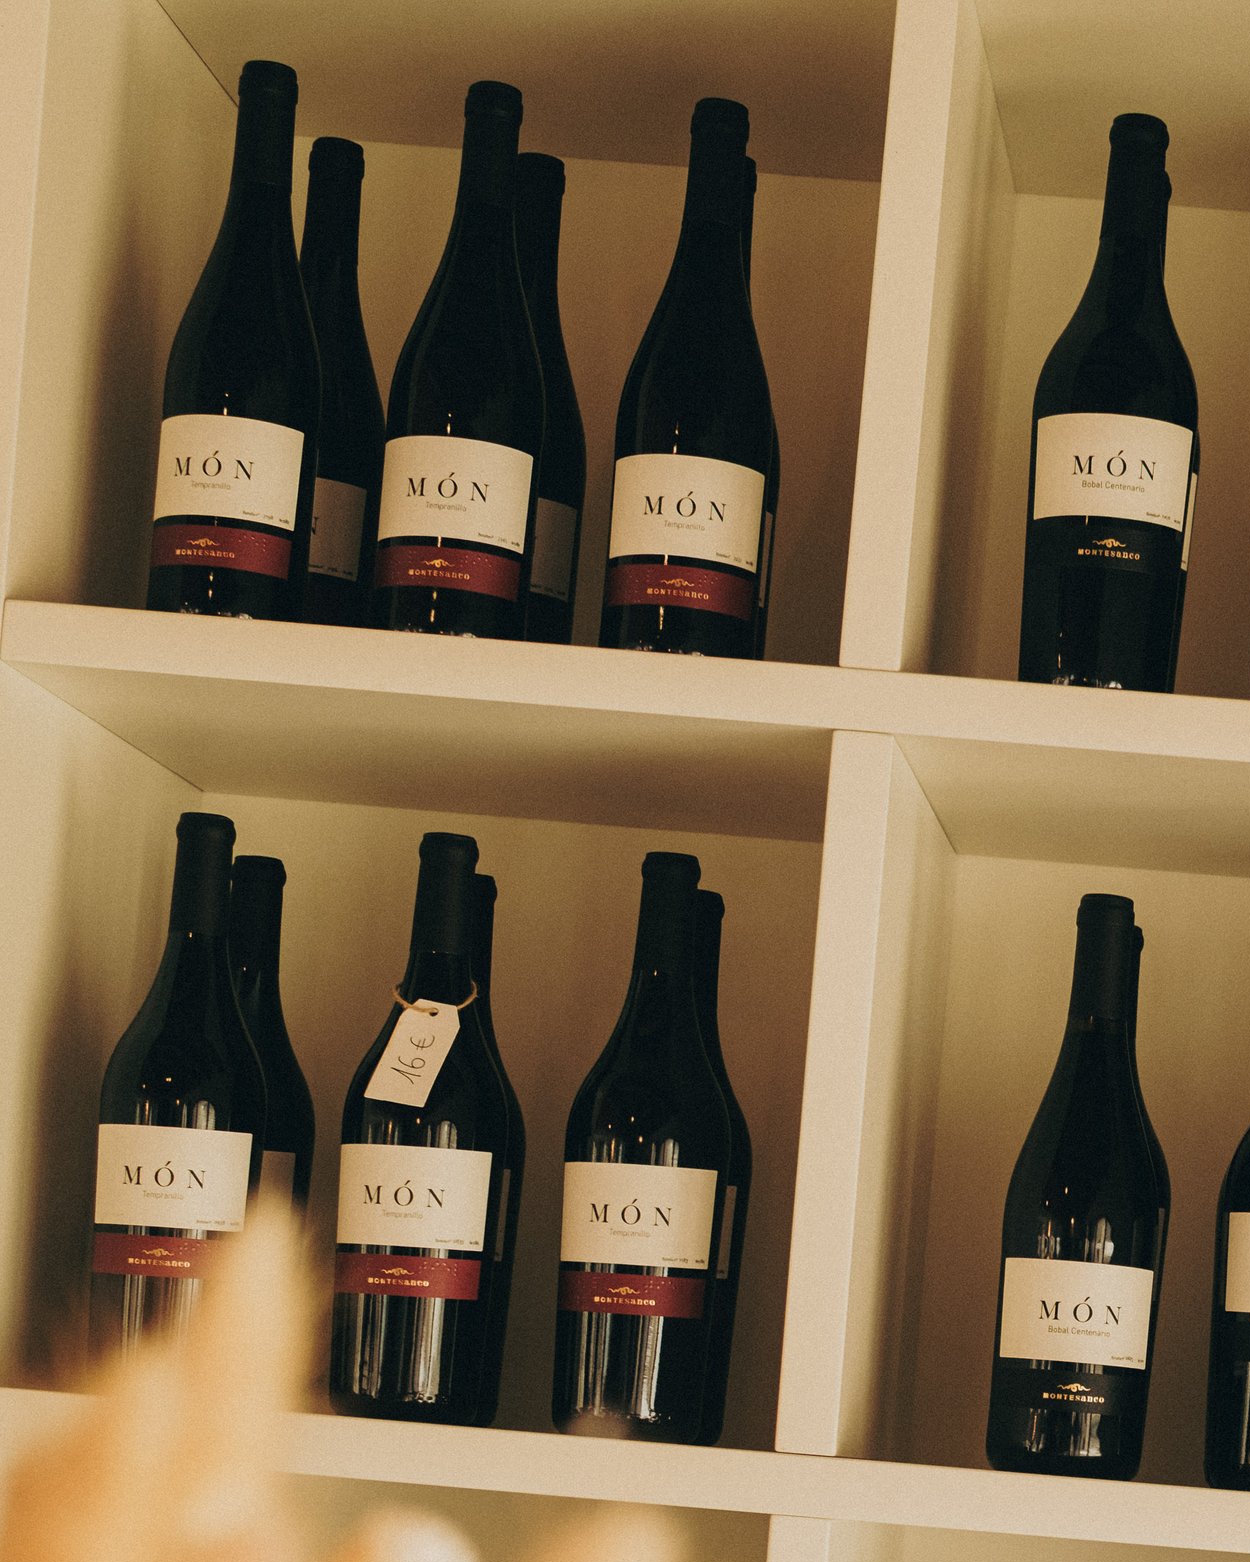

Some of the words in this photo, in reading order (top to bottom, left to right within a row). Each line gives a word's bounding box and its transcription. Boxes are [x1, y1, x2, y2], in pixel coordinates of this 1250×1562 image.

[174, 450, 255, 481] MÓN
[1073, 450, 1156, 481] MÓN
[406, 472, 490, 503] MÓN
[1081, 479, 1103, 490] Bobal
[1105, 481, 1145, 493] Centenario
[643, 491, 727, 522] MÓN
[123, 1161, 207, 1190] MÓN
[363, 1180, 446, 1209] MÓN
[589, 1198, 673, 1228] MÓN
[1039, 1296, 1122, 1326] MÓN
[1048, 1324, 1069, 1334] Bobal
[1071, 1326, 1111, 1339] Centenario
